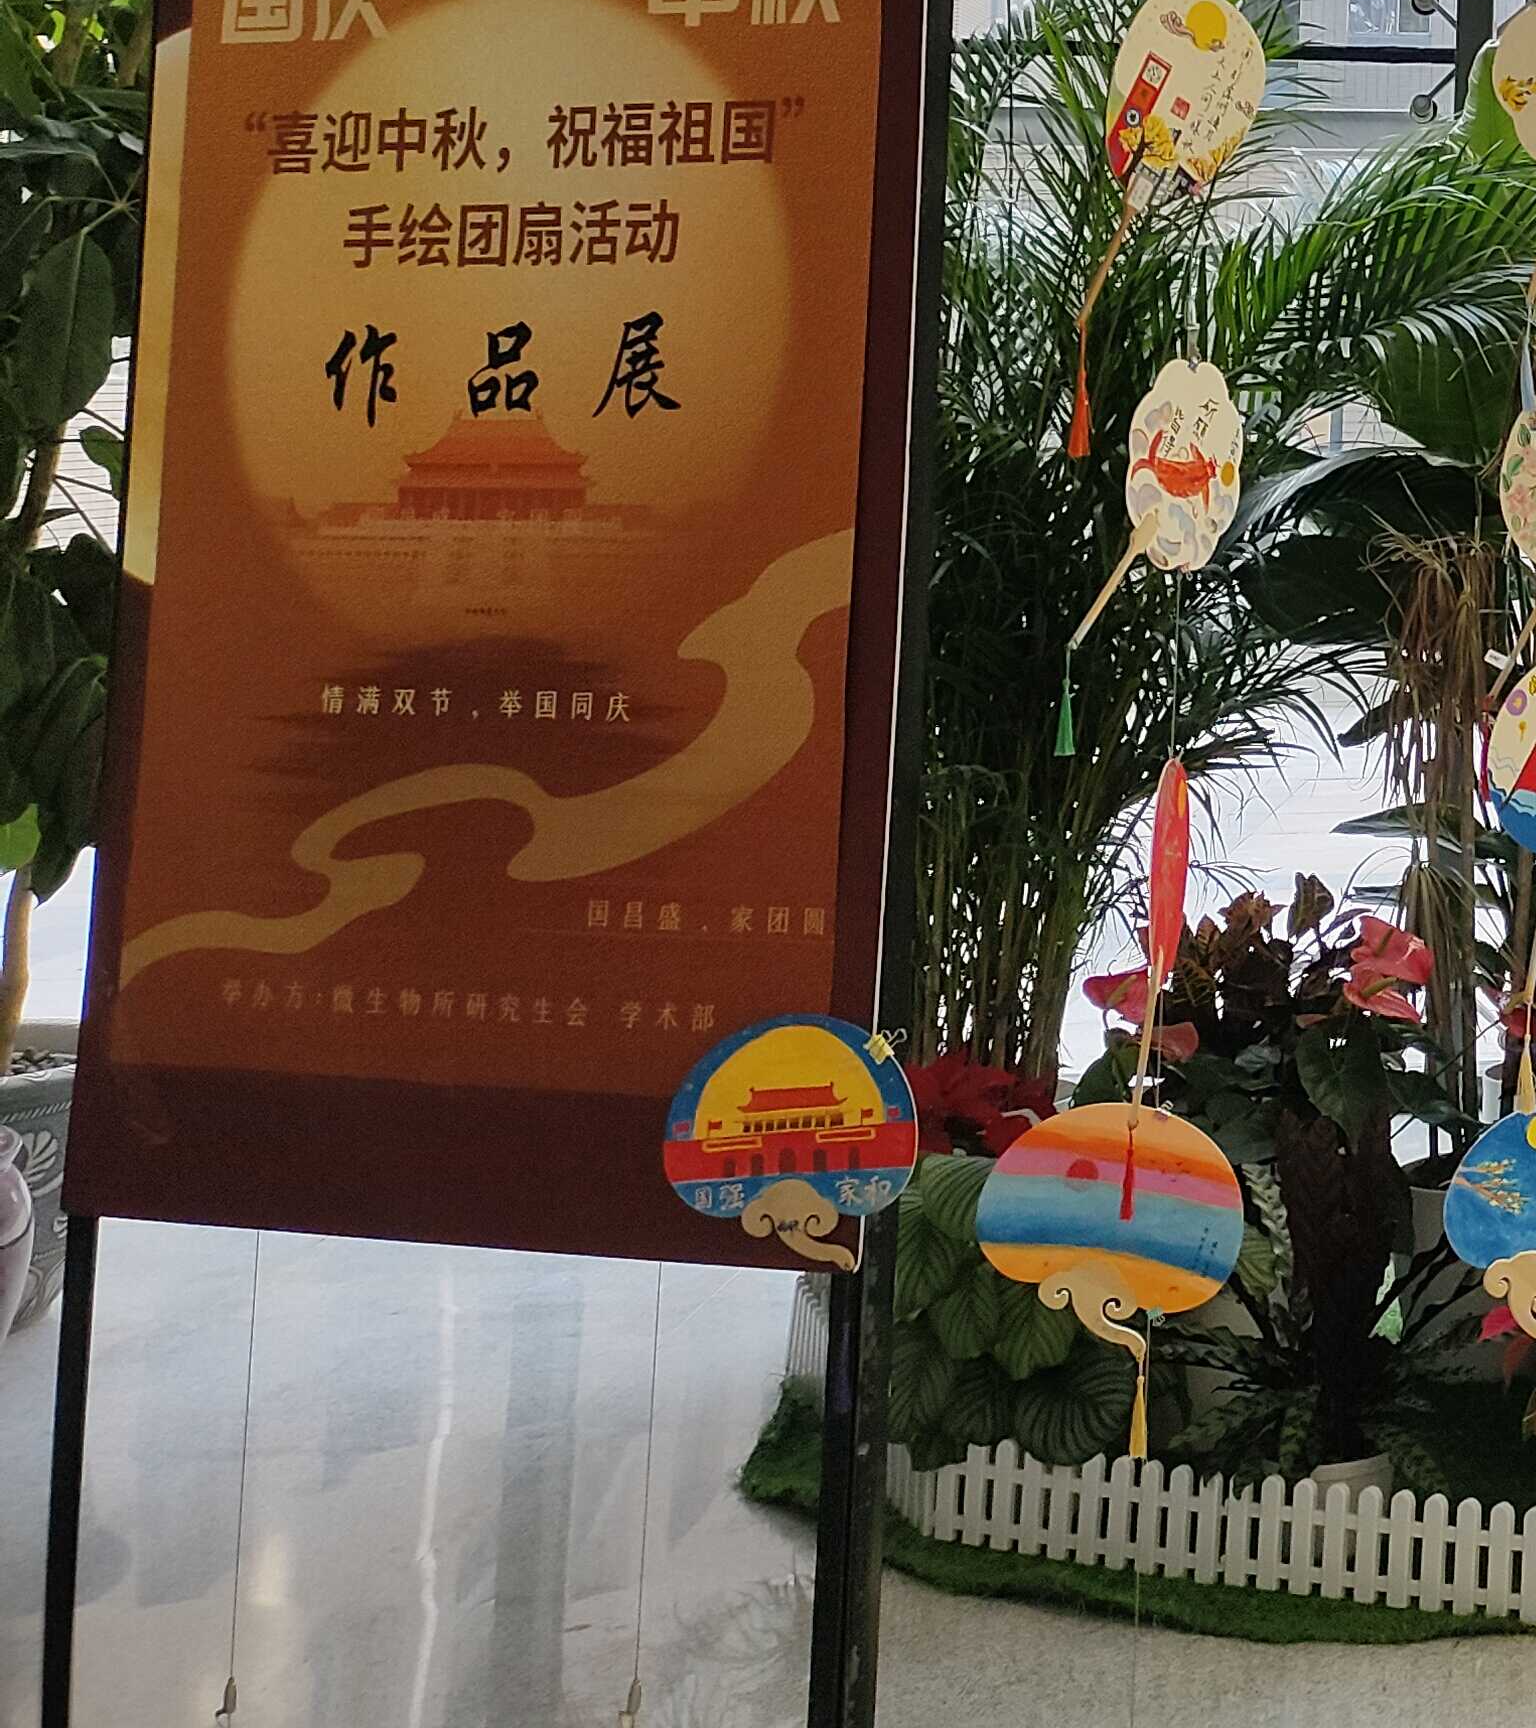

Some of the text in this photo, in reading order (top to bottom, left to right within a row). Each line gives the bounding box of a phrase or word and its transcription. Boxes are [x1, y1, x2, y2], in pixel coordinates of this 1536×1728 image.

[341, 198, 681, 271] 手绘团扇活动
[694, 1175, 893, 1210] 国强 家和
